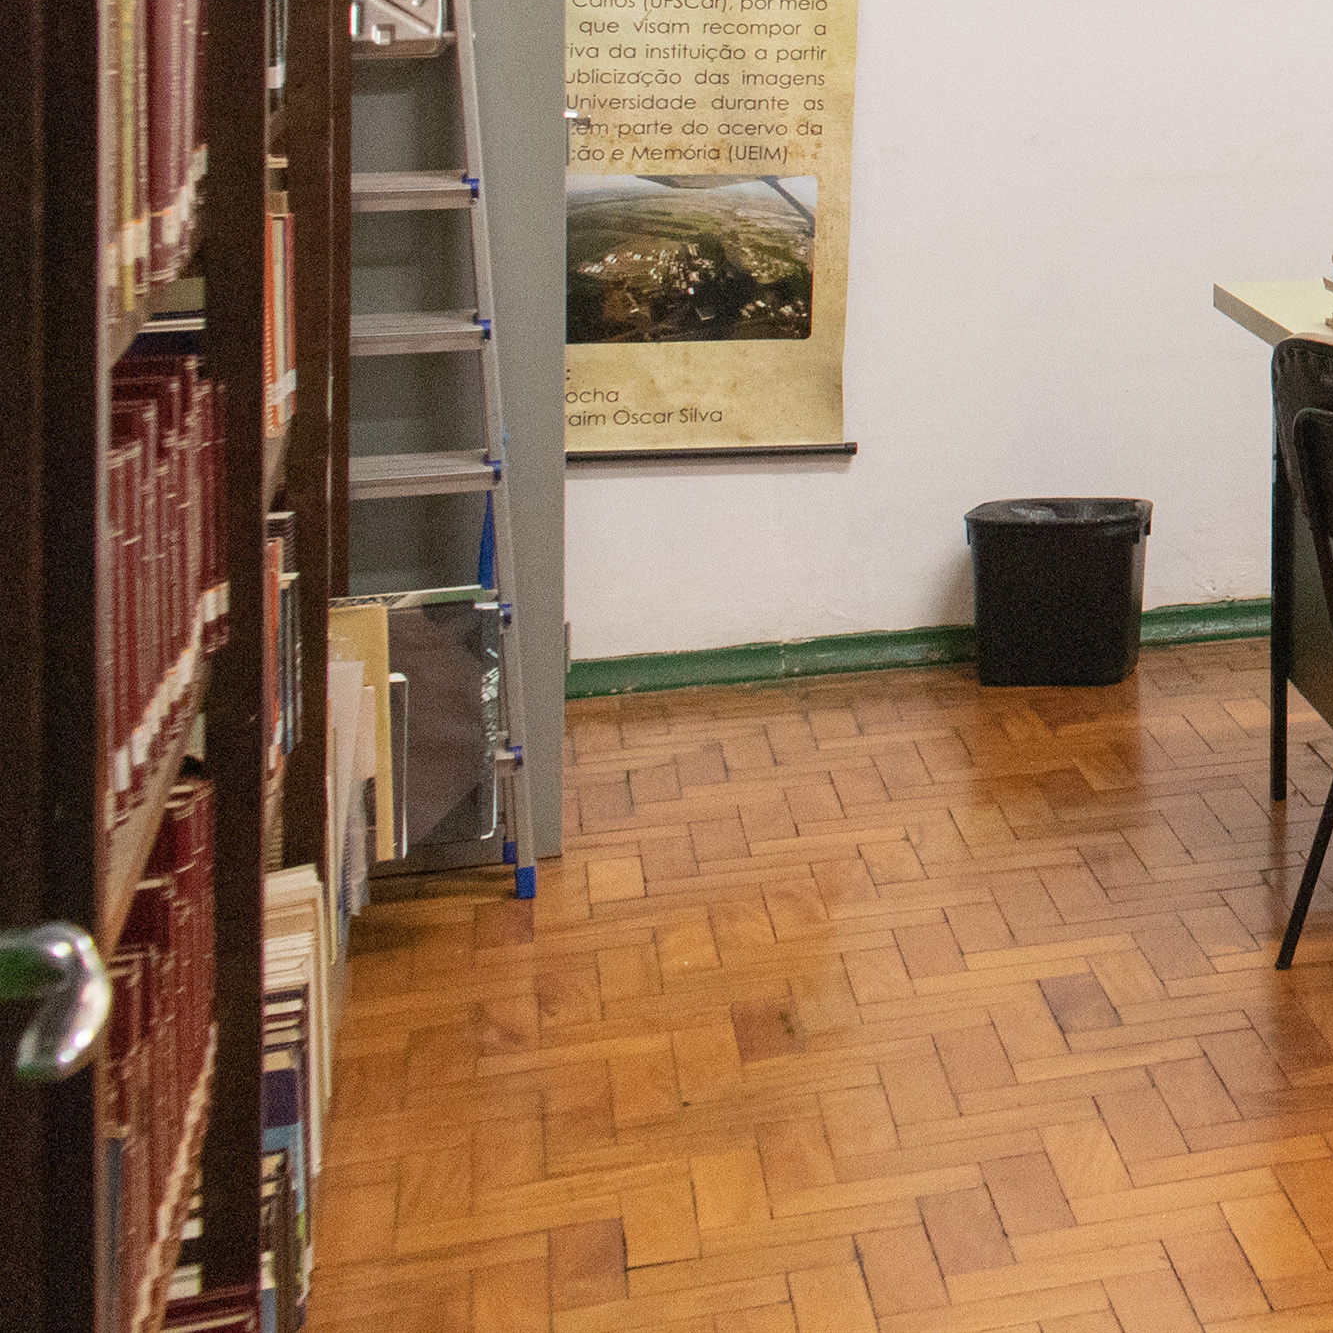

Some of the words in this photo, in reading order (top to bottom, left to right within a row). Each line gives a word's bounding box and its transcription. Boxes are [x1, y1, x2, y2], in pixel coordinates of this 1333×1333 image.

[579, 20, 620, 37] que
[634, 19, 690, 35] visam
[703, 22, 802, 39] recompor
[814, 24, 827, 37] a
[609, 43, 636, 60] da
[645, 43, 747, 64] instituição
[754, 47, 768, 61] a
[776, 44, 827, 64] partir
[566, 69, 682, 89] ublicização
[694, 69, 730, 86] das
[741, 69, 825, 90] imagens
[566, 94, 697, 111] Universidade
[711, 96, 790, 112] durante
[803, 97, 824, 111] as
[617, 119, 673, 140] parte
[681, 119, 709, 136] do
[717, 123, 788, 138] acervo
[796, 121, 823, 137] da
[611, 148, 625, 161] e
[631, 142, 721, 161] Memória
[728, 143, 789, 165] (UEIM)
[565, 388, 620, 404] ocha
[566, 410, 607, 427] aim
[613, 409, 675, 426] Oscar
[679, 408, 723, 424] Silva
